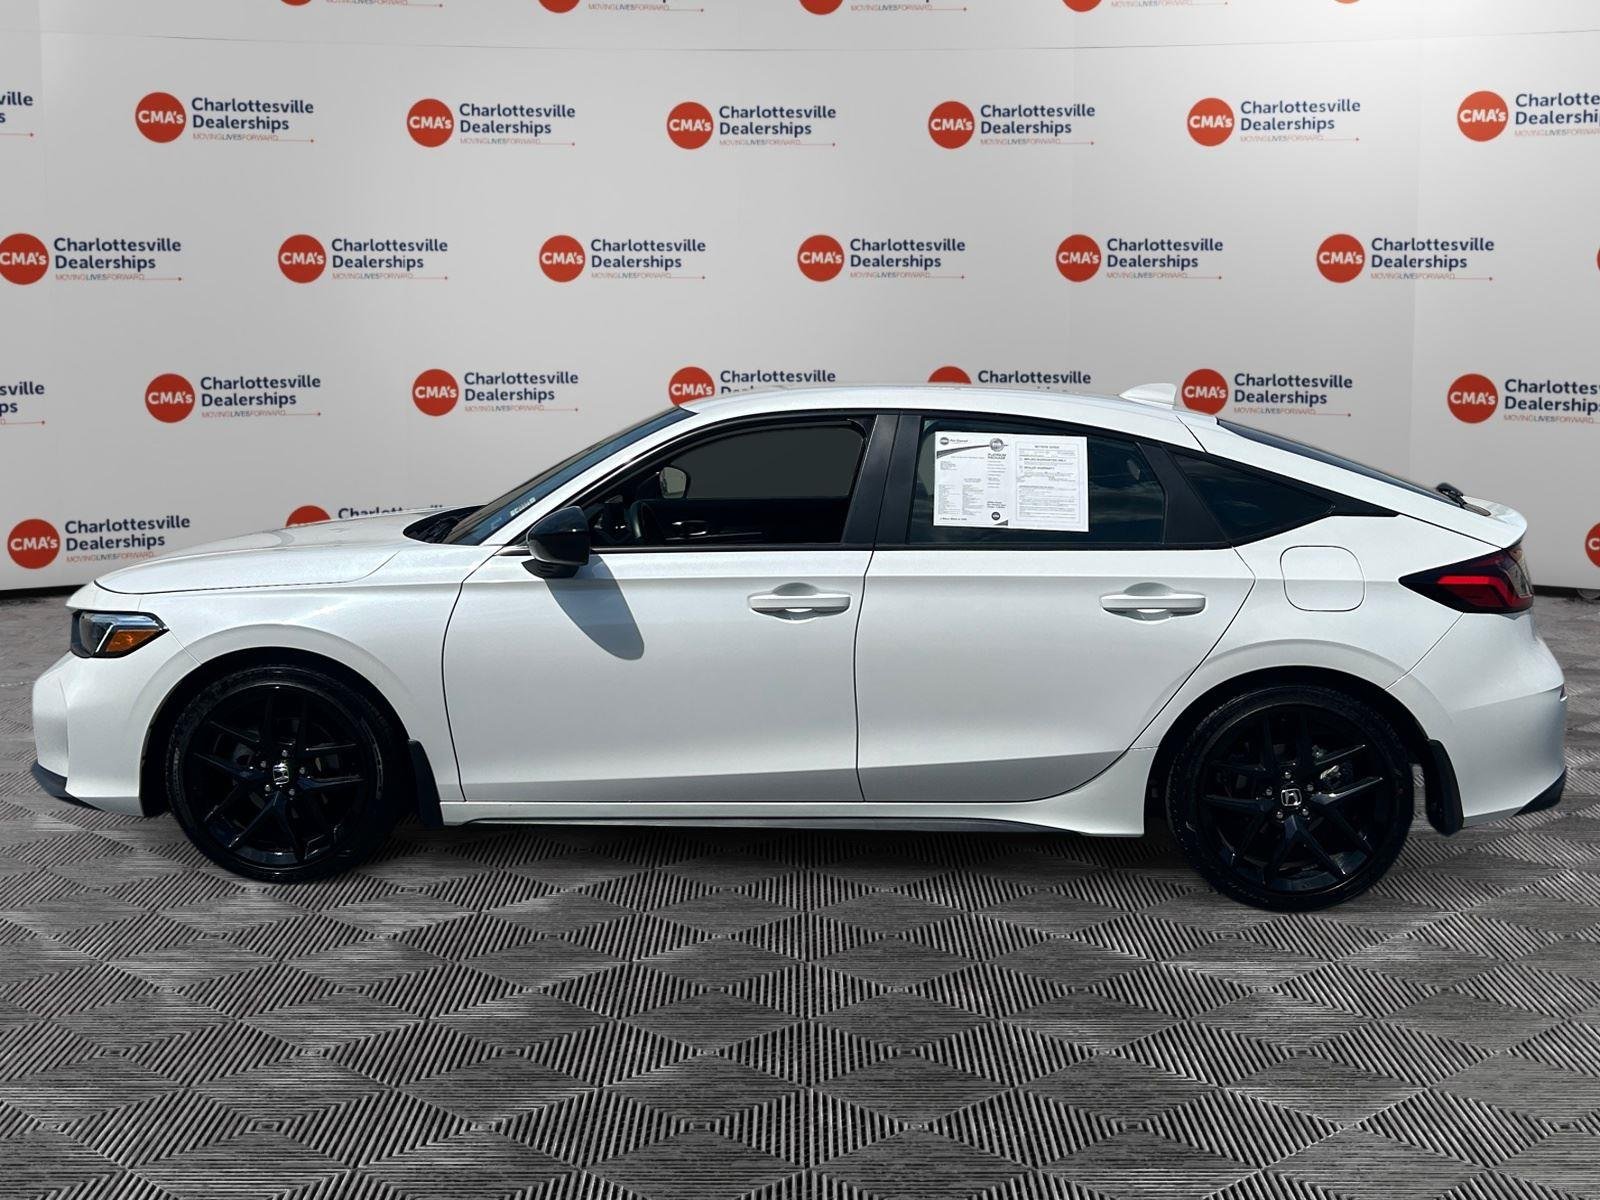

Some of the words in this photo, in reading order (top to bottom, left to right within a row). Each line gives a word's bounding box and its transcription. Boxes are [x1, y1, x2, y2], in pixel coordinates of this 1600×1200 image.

[192, 97, 313, 113] Charlottesville
[459, 103, 575, 118] Charlottesville
[719, 105, 836, 119] Charlottesville
[981, 104, 1095, 118] Charlottesville
[1240, 99, 1360, 114] Charlottesville
[139, 111, 184, 125] CMA's
[1189, 115, 1233, 129] CMA's
[1460, 108, 1506, 123] CMA's
[1516, 109, 1600, 126] Dealershi
[193, 115, 289, 134] Dealerships
[409, 116, 452, 130] CMA's
[460, 120, 551, 137] Dealerships
[670, 119, 712, 132] CMA's
[720, 122, 812, 138] Dealerships
[931, 118, 973, 131] CMA's
[981, 121, 1072, 137] Dealerships
[1241, 117, 1334, 133] Dealerships
[54, 237, 181, 252] Charlottesville
[331, 238, 448, 252] Charlottesville
[591, 239, 706, 252] Charlottesville
[850, 238, 965, 251] Charlottesville
[1107, 238, 1223, 251] Charlottesville
[1371, 237, 1494, 251] Charlottesville
[0, 252, 46, 266] CMA's
[55, 255, 156, 272] Dealerships
[281, 253, 324, 265] CMA's
[333, 255, 424, 271] Dealerships
[541, 252, 583, 265] CMA's
[592, 255, 682, 271] Dealerships
[800, 252, 842, 264] CMA's
[851, 254, 941, 271] Dealerships
[1060, 252, 1099, 264] CMA's
[1107, 254, 1198, 271] Dealerships
[1319, 252, 1363, 265] CMA's
[1371, 254, 1467, 271] Dealerships
[200, 375, 320, 390] Charlottesville
[464, 371, 578, 385] Charlottesville
[720, 370, 836, 383] Charlottesville
[978, 370, 1091, 384] Charlottesville
[1234, 373, 1352, 388] Charlottesville
[415, 386, 457, 399] CMA's
[671, 384, 712, 396] CMA's
[1184, 386, 1226, 399] CMA's
[1505, 379, 1600, 395] Charlottes
[148, 392, 193, 405] CMA's
[202, 392, 296, 408] Dealerships
[465, 388, 555, 403] Dealerships
[1234, 389, 1327, 407] Dealerships
[1450, 391, 1496, 405] CMA's
[1505, 396, 1600, 415] Dealership
[65, 515, 190, 532] Charlottesville
[11, 537, 57, 550] CMA's
[66, 533, 165, 551] Dealerships
